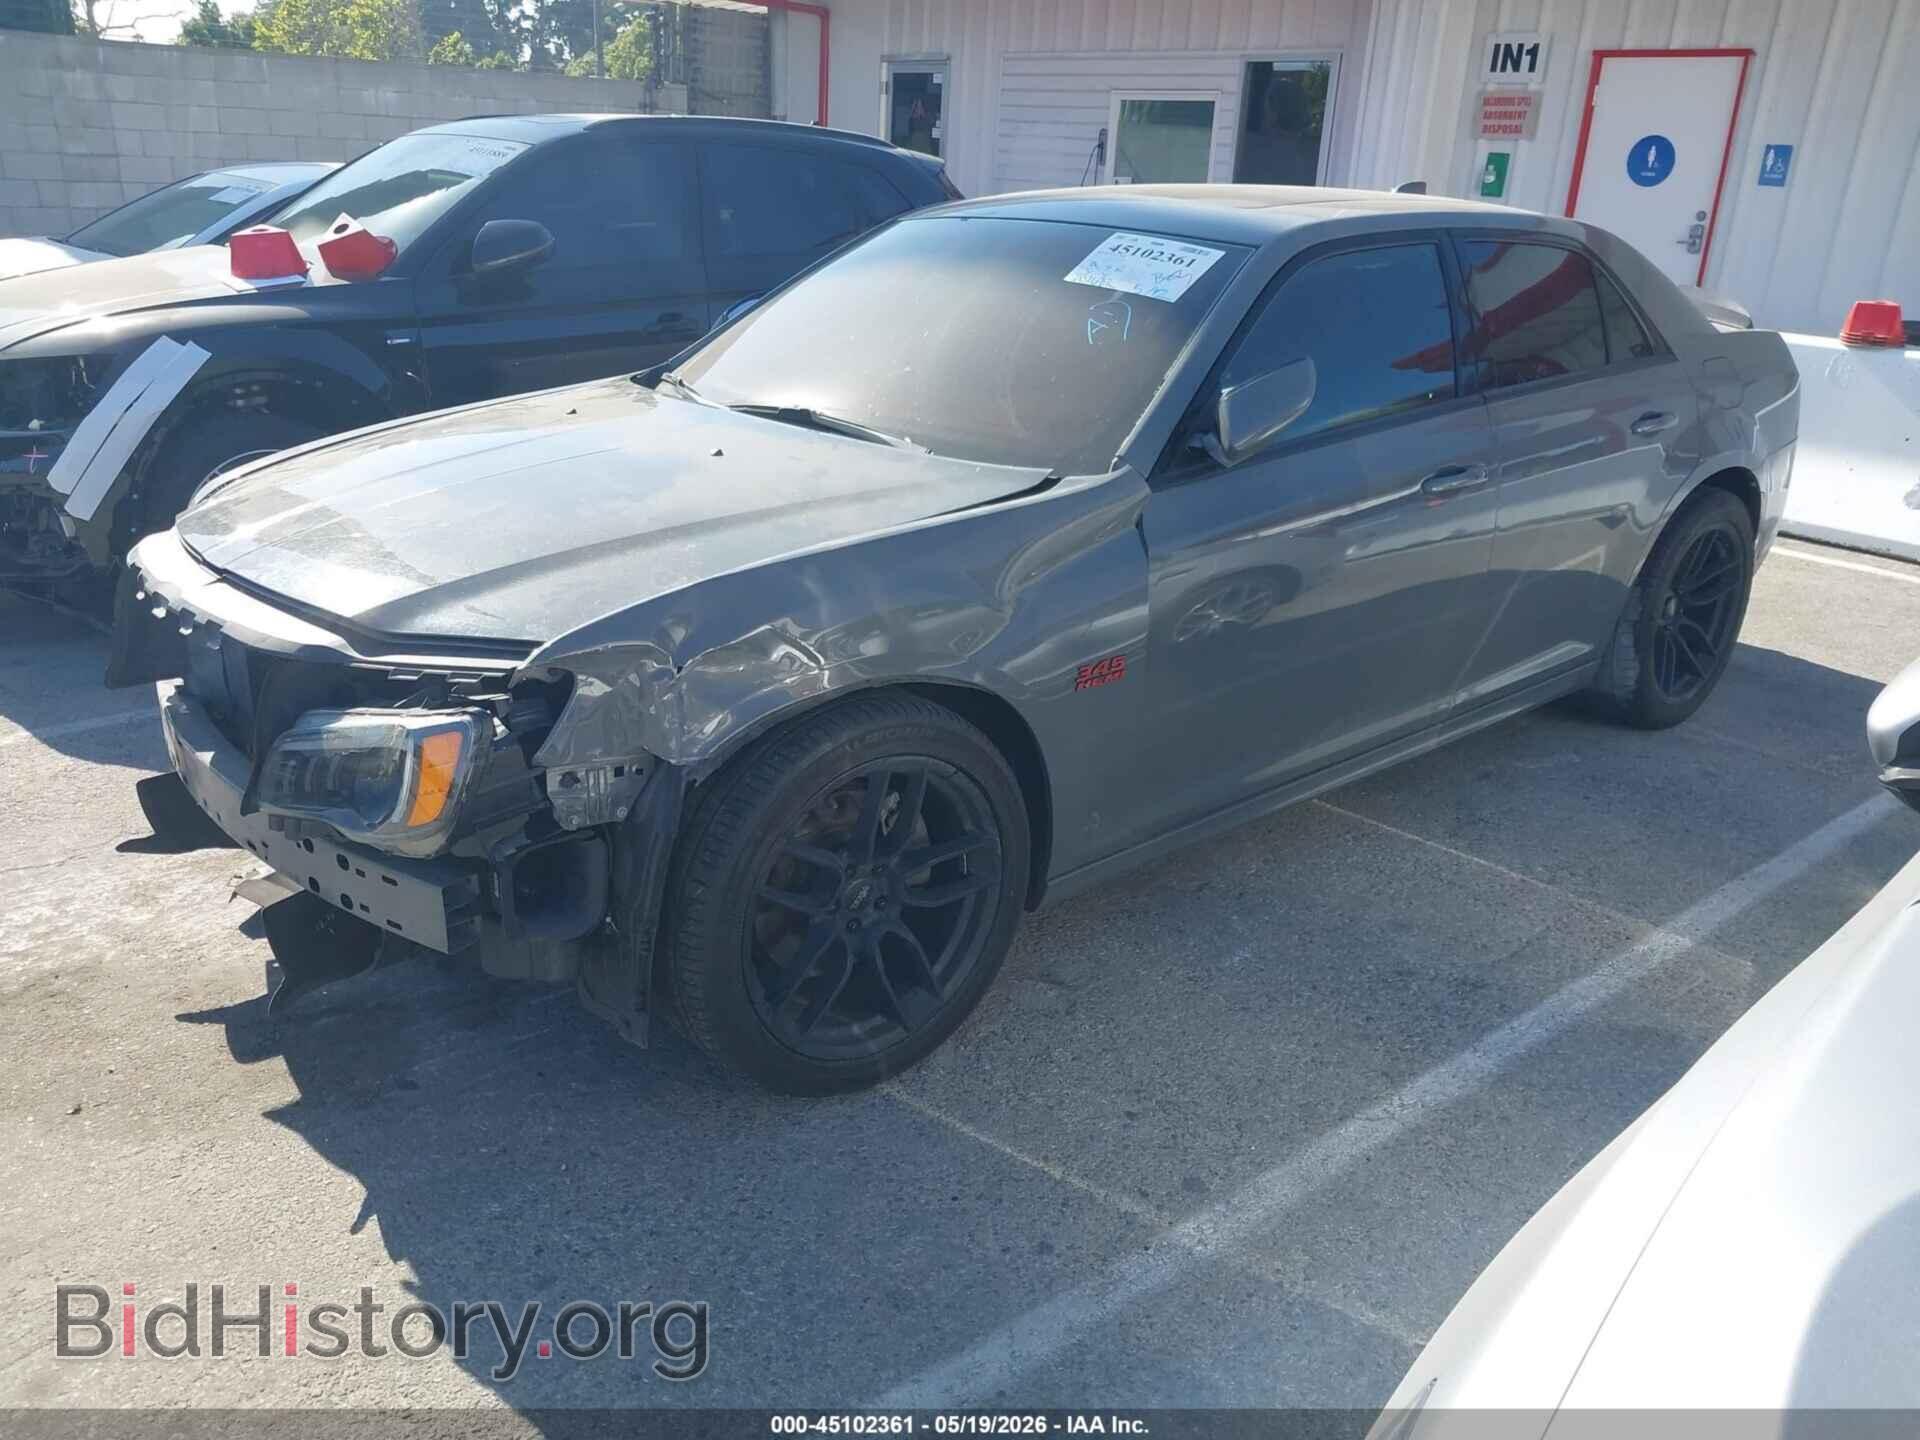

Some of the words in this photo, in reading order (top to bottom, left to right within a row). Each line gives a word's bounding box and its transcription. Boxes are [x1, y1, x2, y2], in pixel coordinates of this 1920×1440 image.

[1489, 43, 1540, 72] IN1
[1481, 124, 1522, 134] DISPOSAL
[1109, 243, 1198, 268] 45102361
